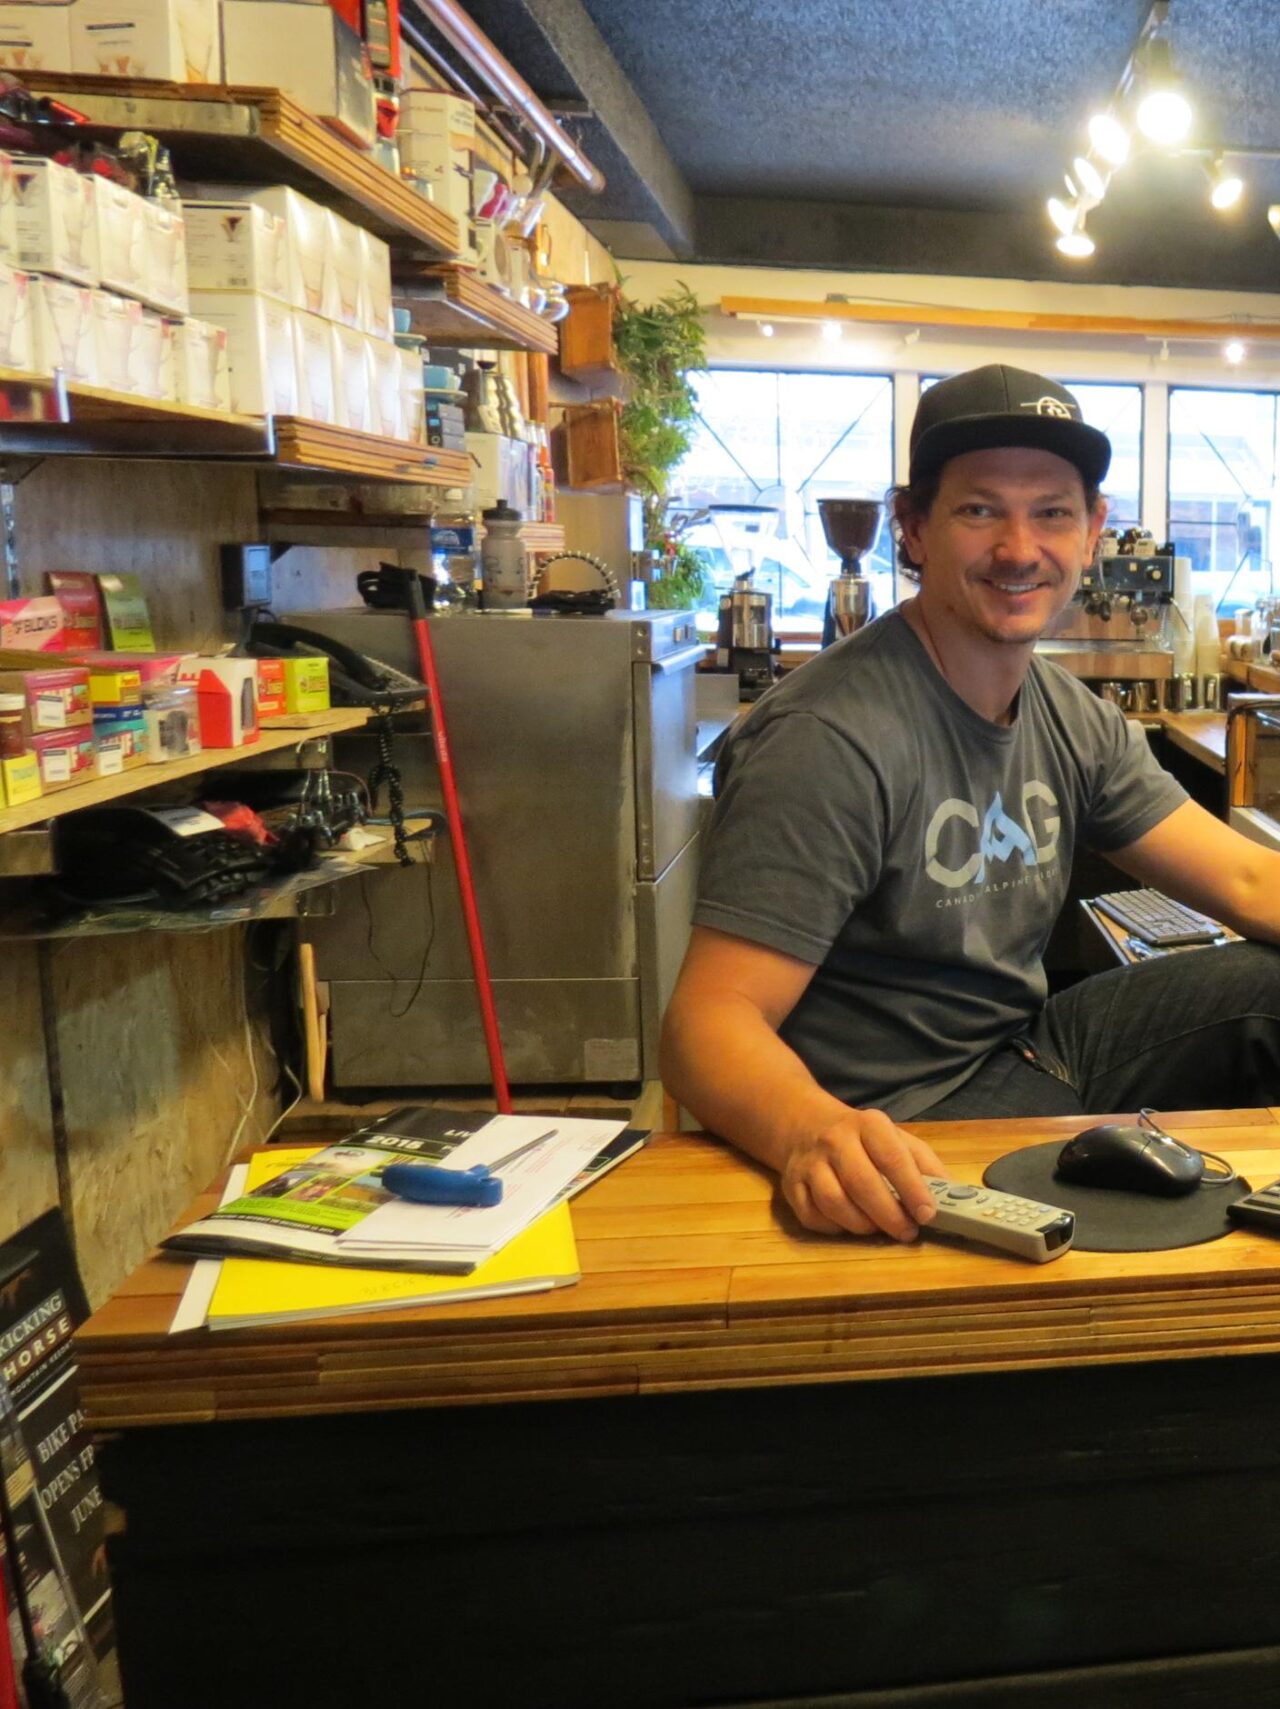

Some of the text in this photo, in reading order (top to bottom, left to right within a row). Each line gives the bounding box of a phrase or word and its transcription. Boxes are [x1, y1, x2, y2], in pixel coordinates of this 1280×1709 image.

[925, 779, 1062, 889] CAG
[3, 1315, 71, 1382] HORSE
[36, 1408, 88, 1465] BIKE PA
[40, 1459, 81, 1511] OPENS
[70, 1484, 104, 1535] JUNE
